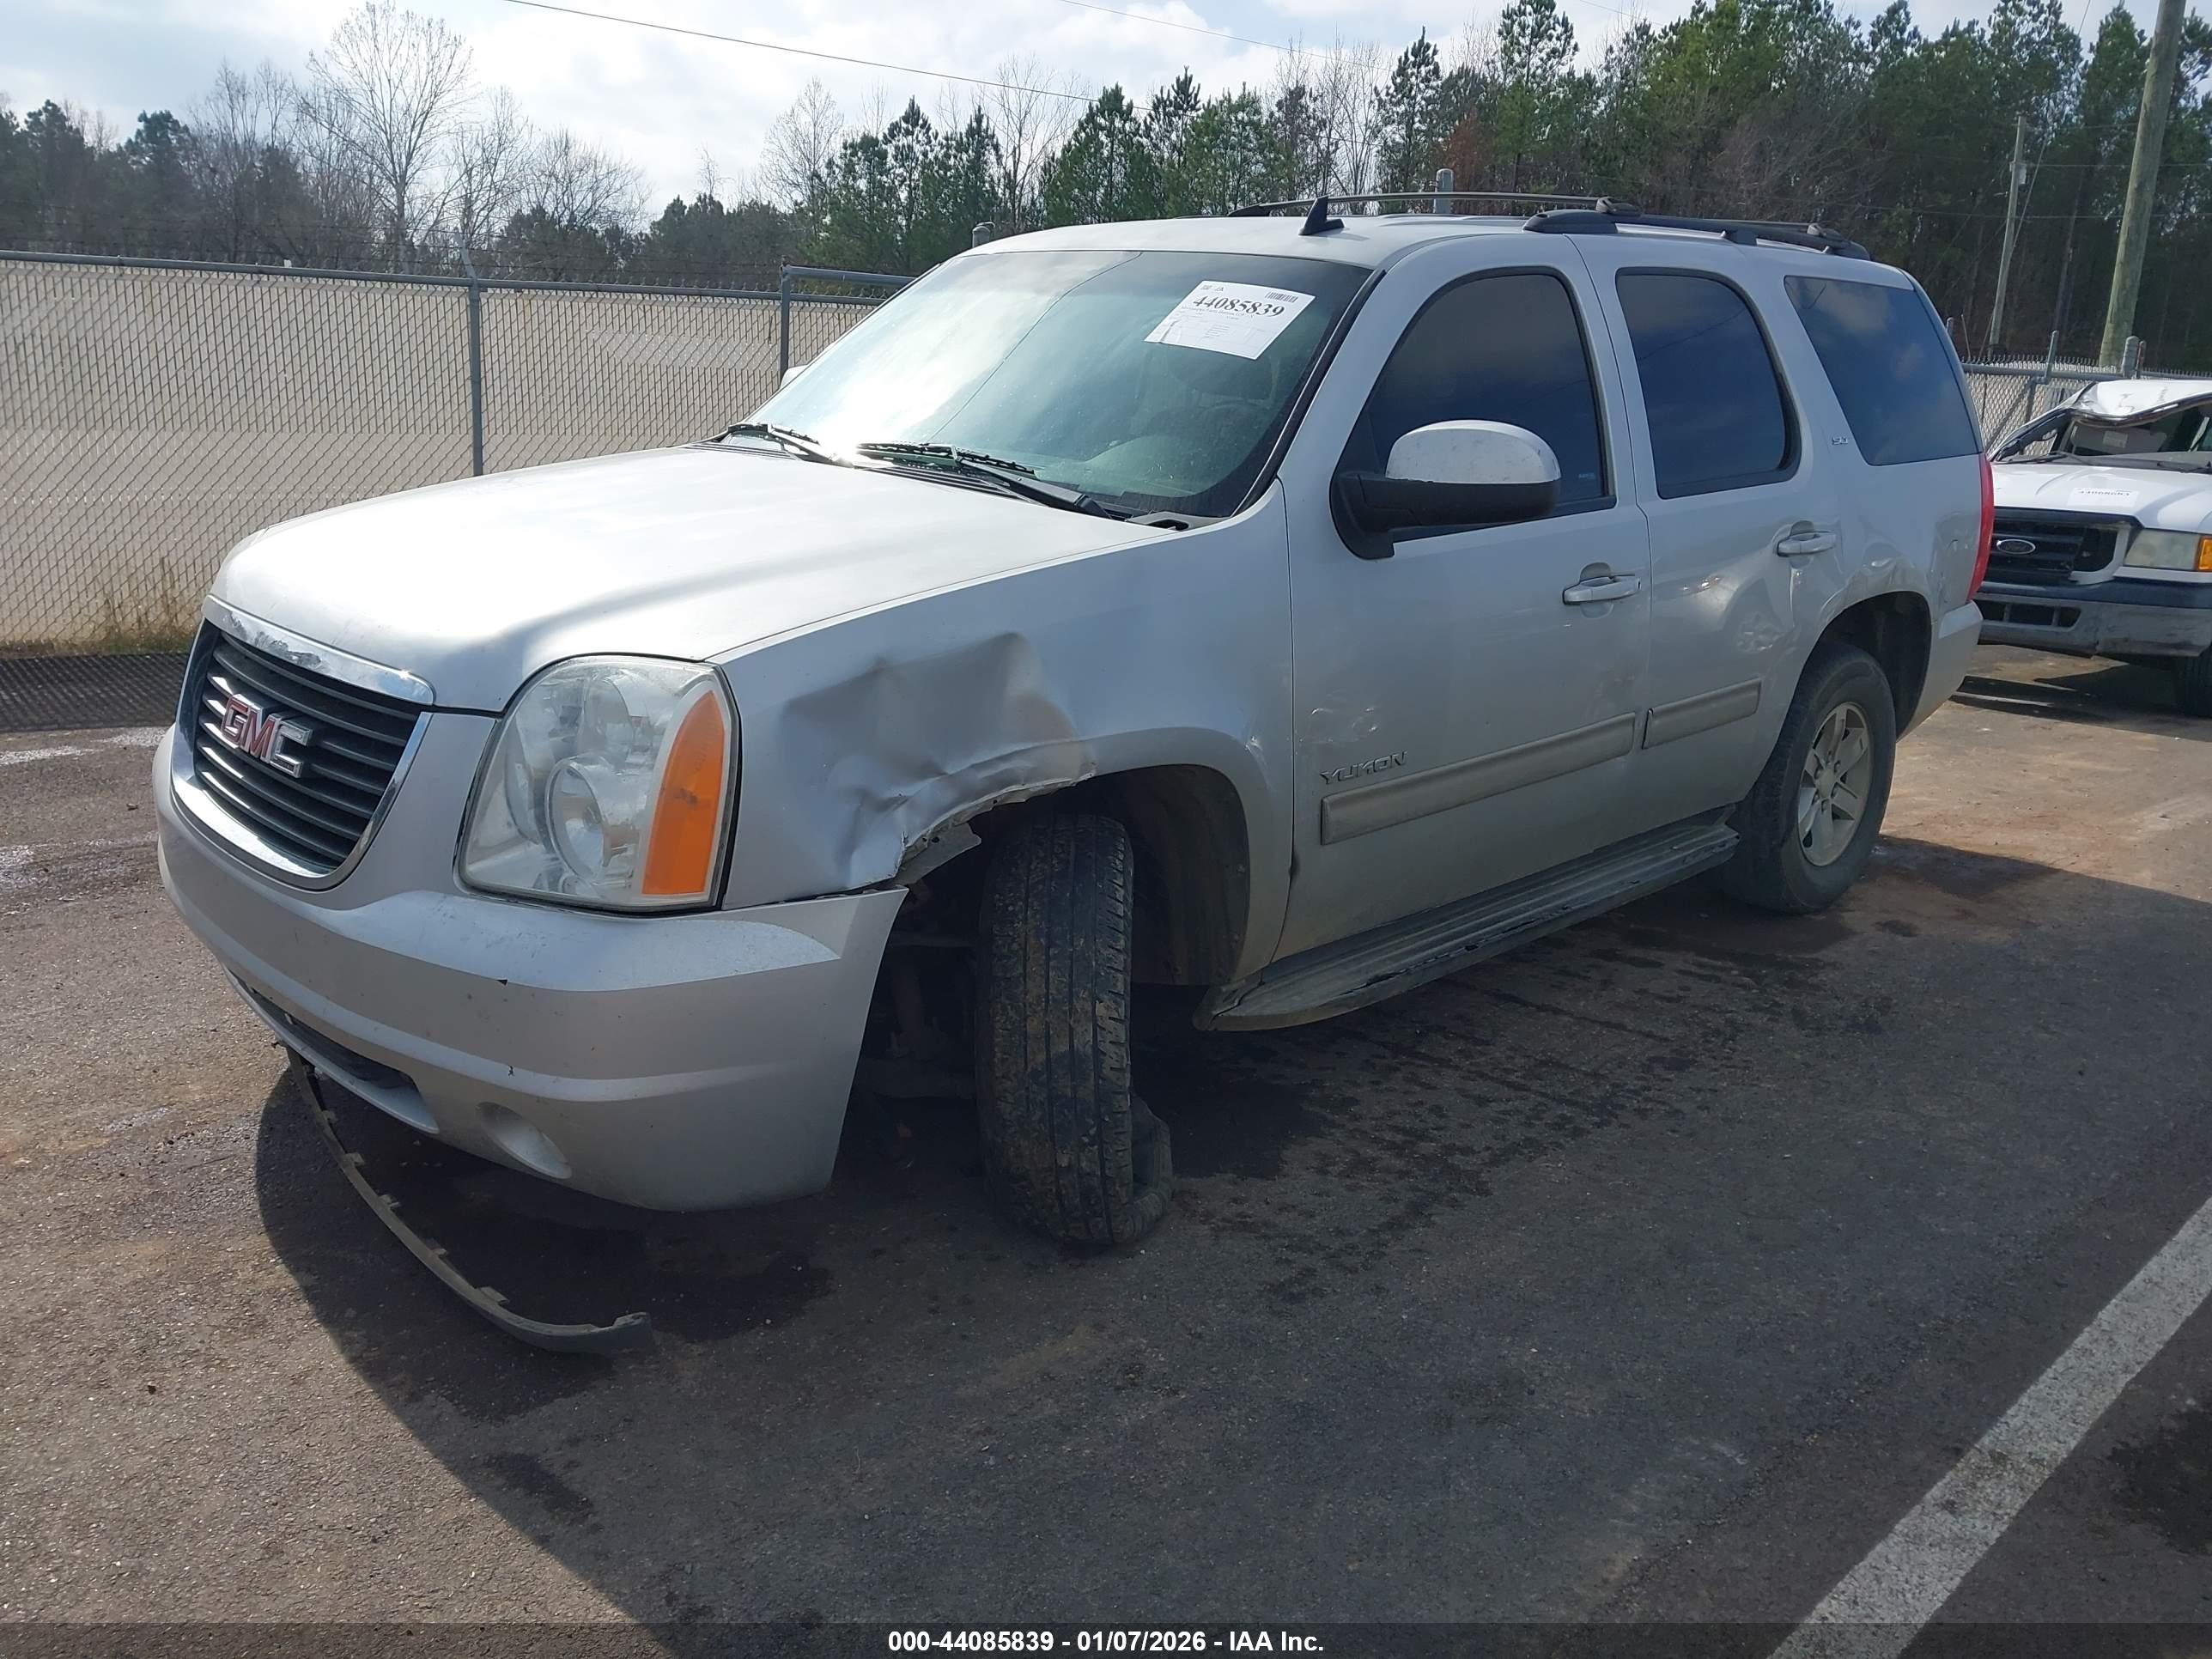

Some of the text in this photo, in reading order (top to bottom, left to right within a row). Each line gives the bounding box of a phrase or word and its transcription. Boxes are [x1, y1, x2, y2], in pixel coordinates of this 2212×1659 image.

[1193, 295, 1285, 318] 44085839
[221, 694, 313, 778] GMC
[1320, 751, 1407, 785] YUKON
